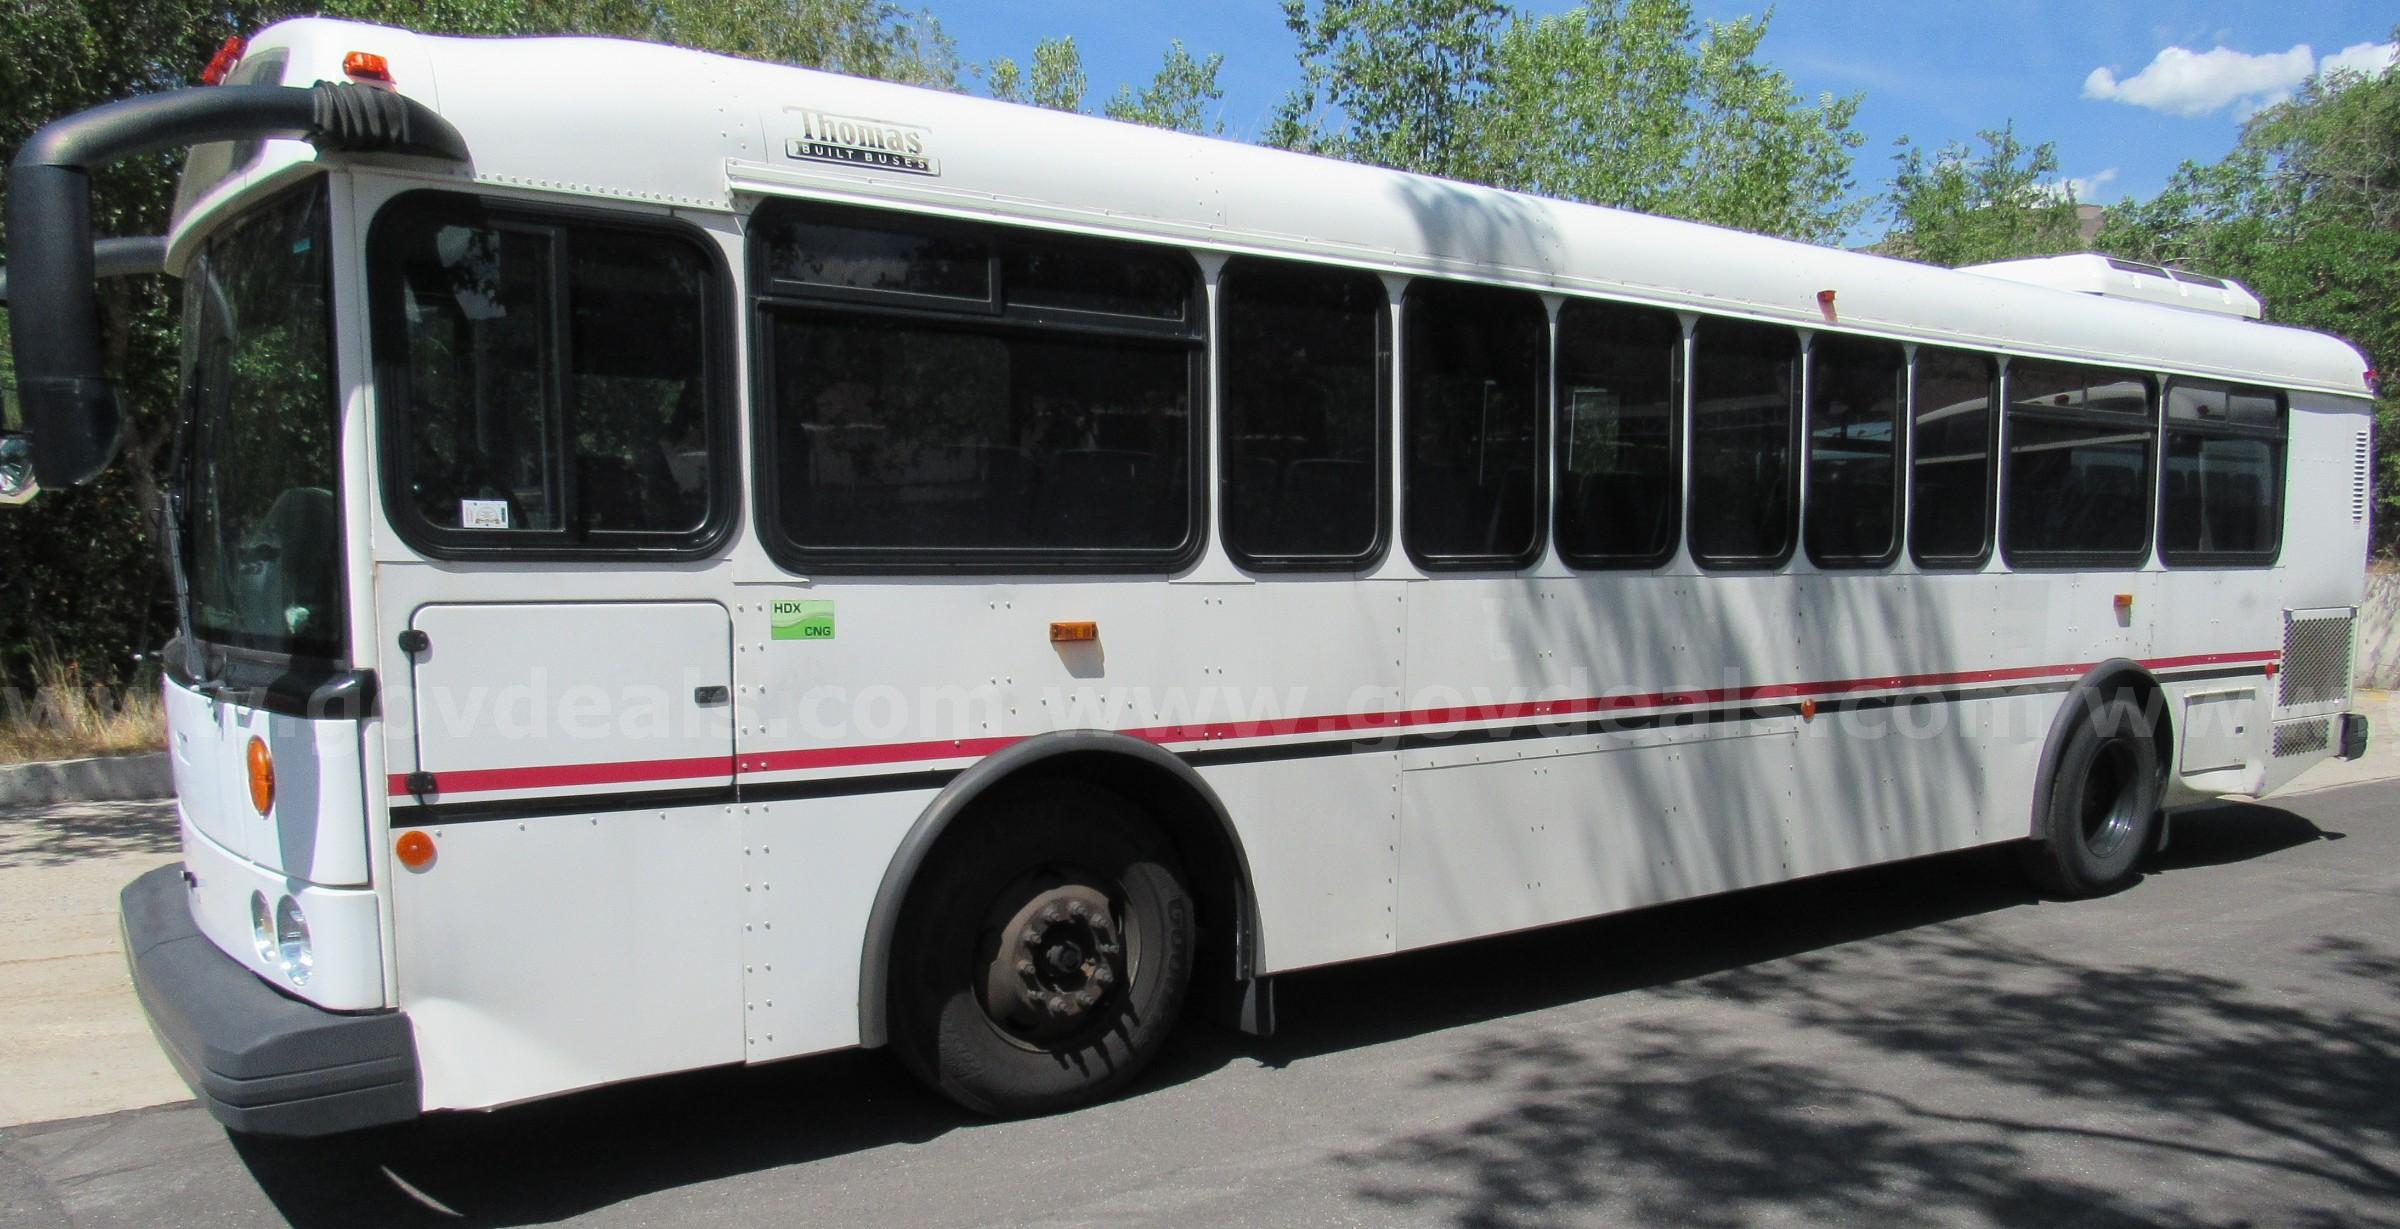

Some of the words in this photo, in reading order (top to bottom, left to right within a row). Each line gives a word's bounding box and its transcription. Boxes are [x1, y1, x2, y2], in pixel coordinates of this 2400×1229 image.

[783, 106, 932, 155] Thomas
[802, 144, 855, 160] BUILT
[864, 152, 926, 169] BUSES
[774, 603, 801, 614] HDX
[804, 626, 831, 637] CNG
